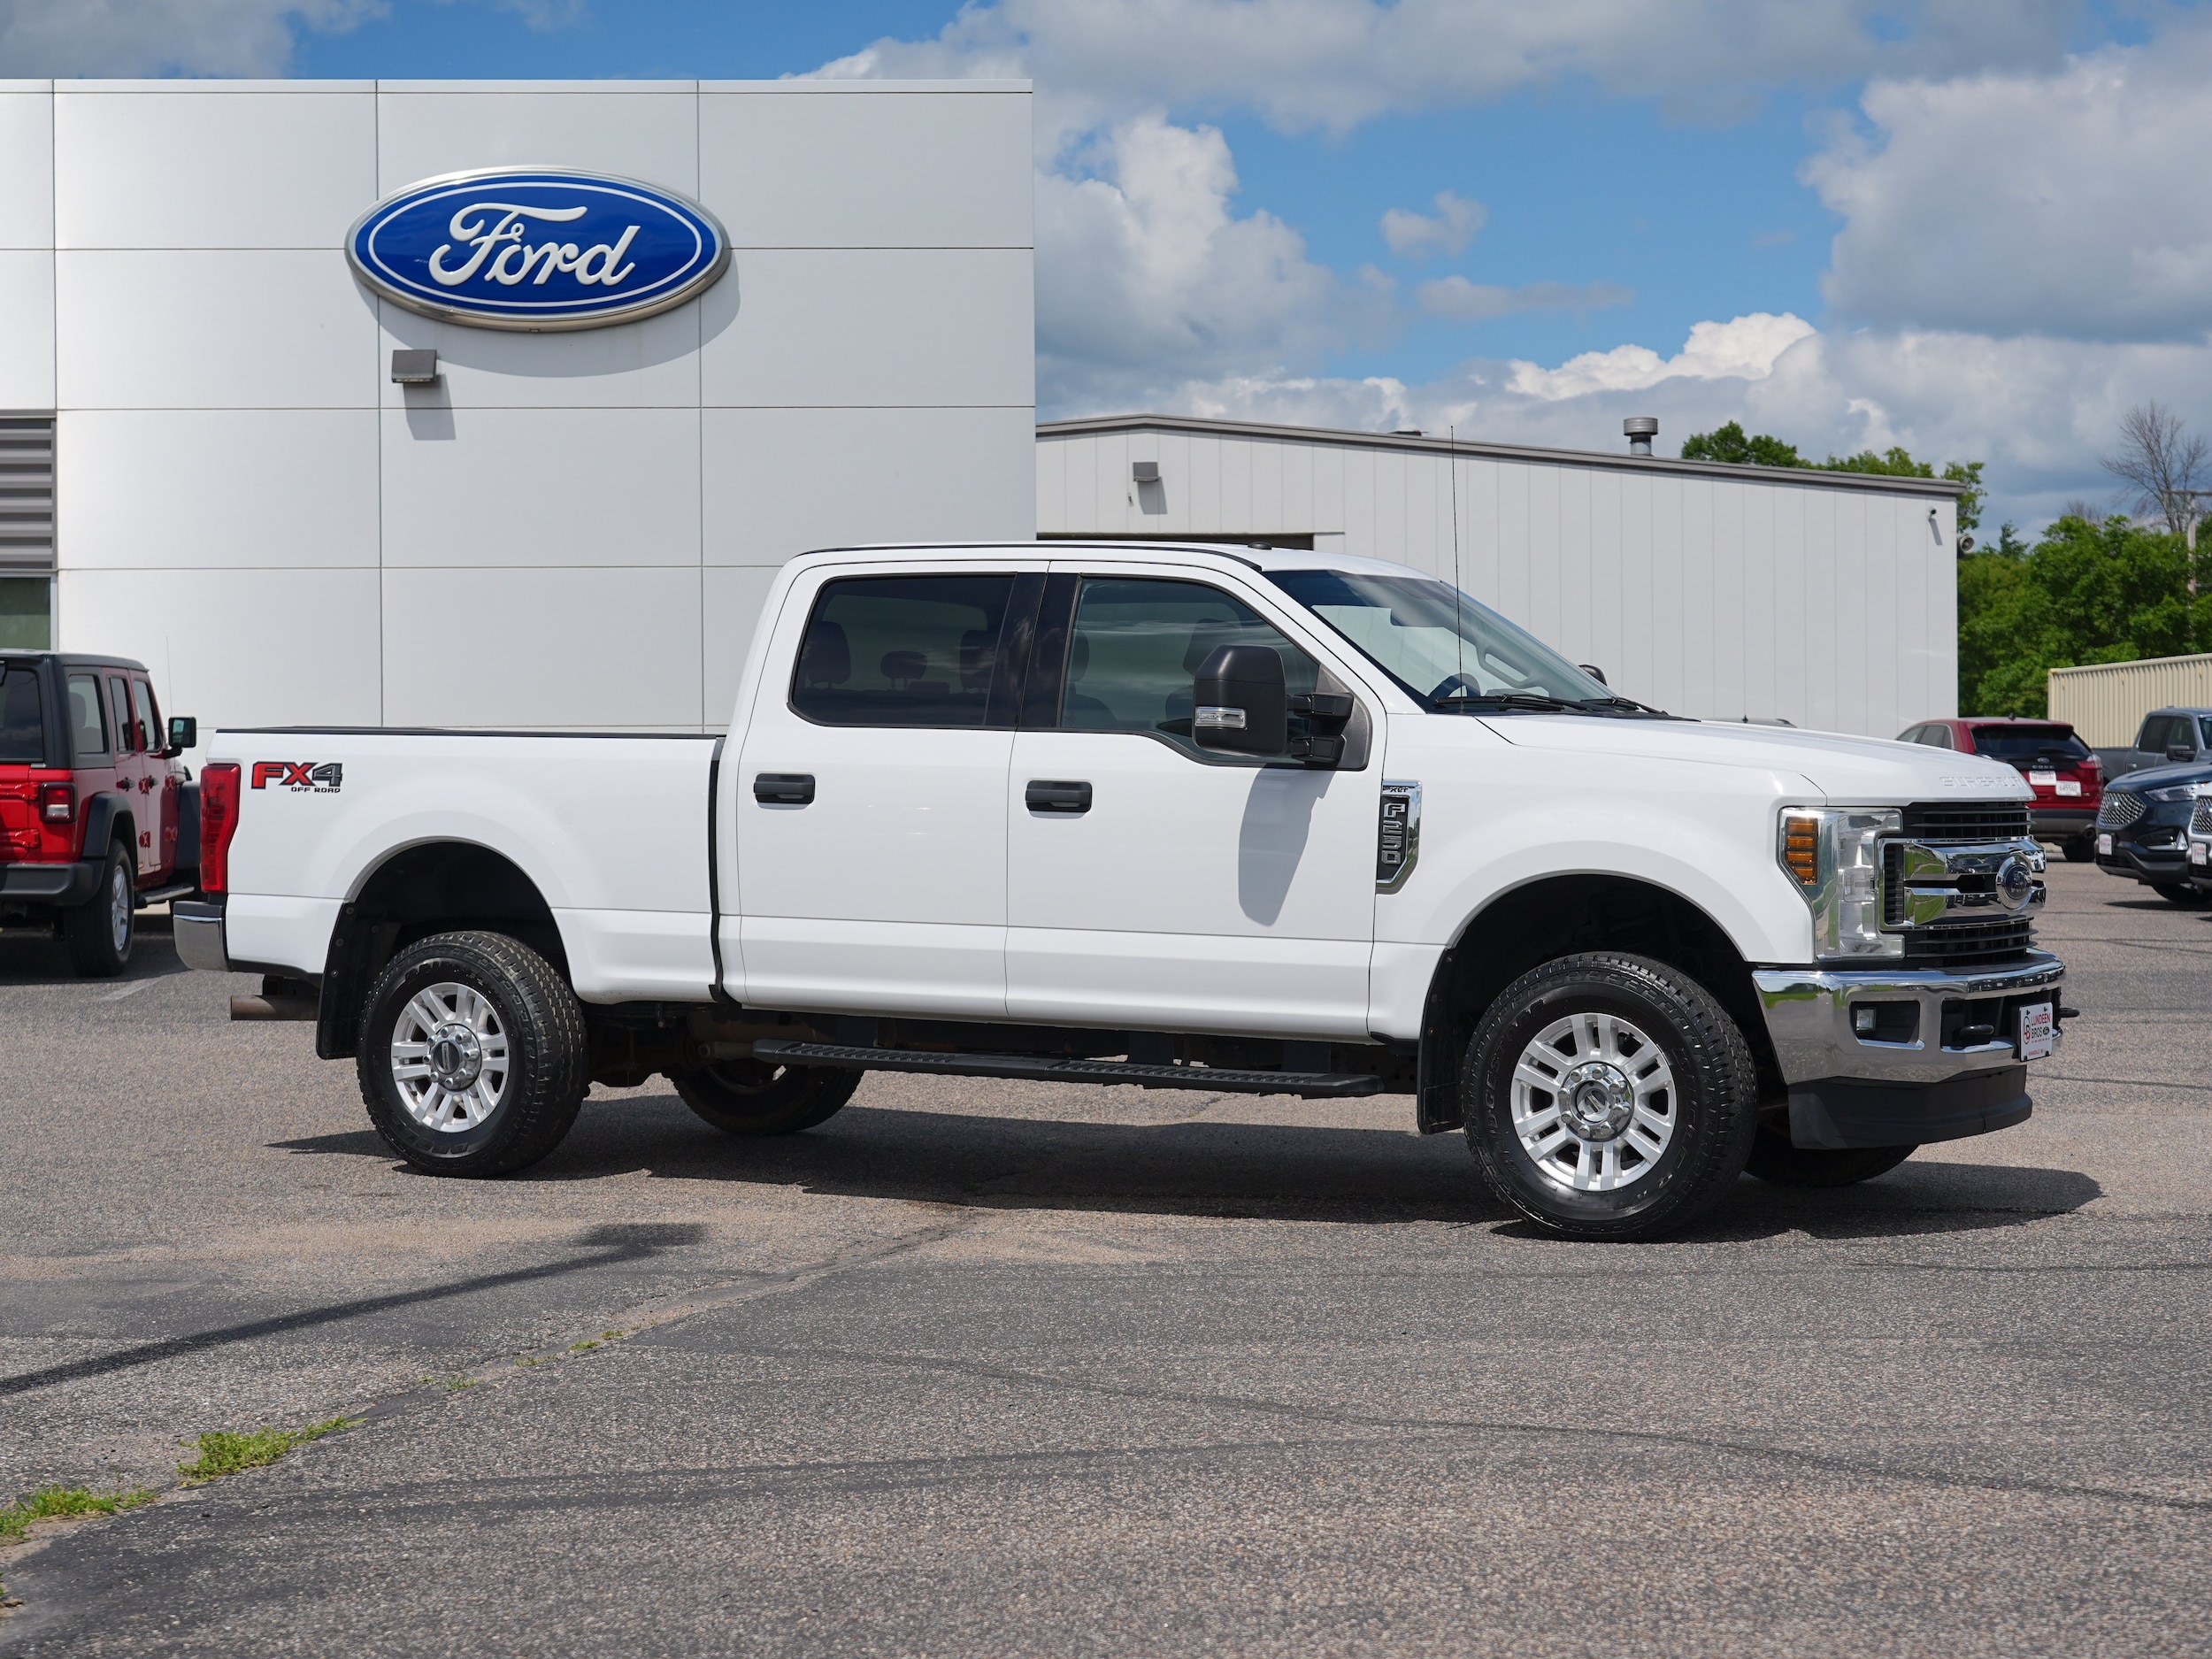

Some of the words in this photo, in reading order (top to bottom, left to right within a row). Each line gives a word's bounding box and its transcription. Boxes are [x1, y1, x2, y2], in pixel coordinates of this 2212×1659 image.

[429, 203, 641, 286] Ford
[251, 761, 342, 789] FX4
[2032, 1013, 2051, 1026] LUNDEEN
